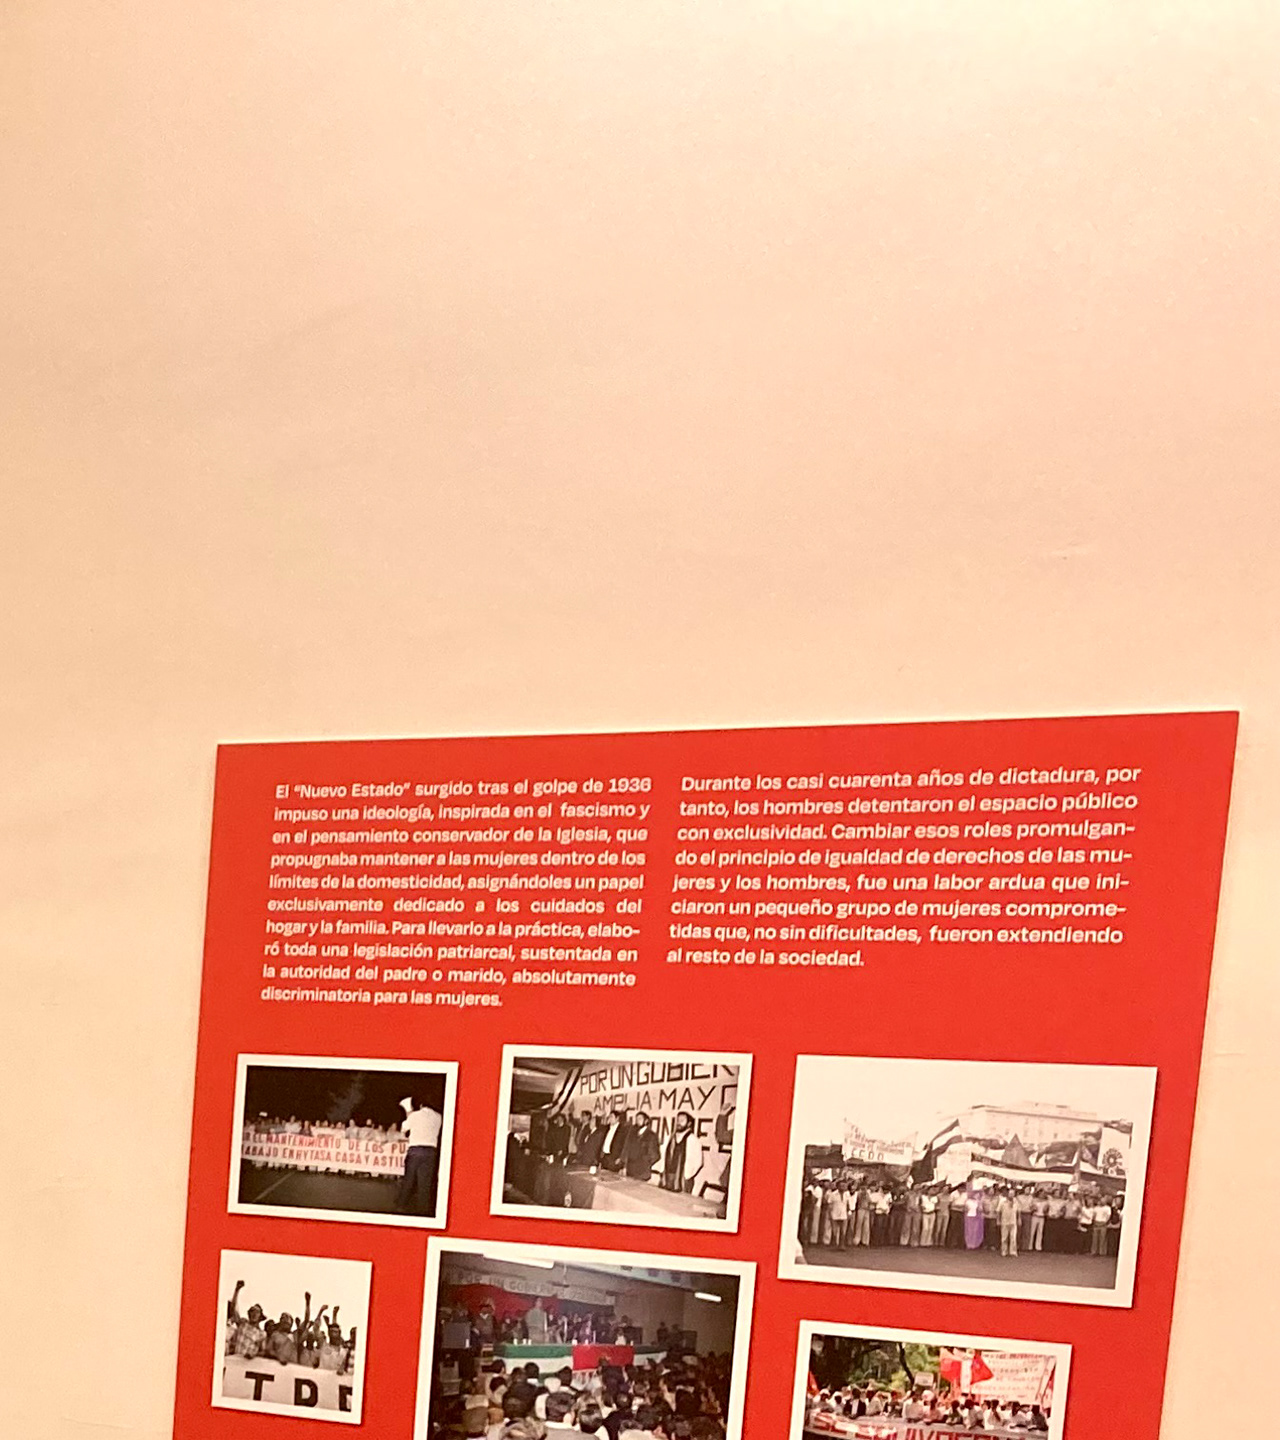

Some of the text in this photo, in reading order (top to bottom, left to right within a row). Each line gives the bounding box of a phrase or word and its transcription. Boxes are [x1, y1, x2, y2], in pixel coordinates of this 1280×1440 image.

[275, 777, 651, 799] El “Nuevo Estado” surgido tras el golpe de 1936
[681, 766, 1141, 791] Durante los casi cuarenta años de dictadura, por
[274, 801, 650, 823] impuso una ideología, inspirada en el fascismo y
[679, 791, 1138, 818] tanto, los hombres detentaron el espacio público
[272, 826, 648, 846] en el pensamiento conservador de la Iglesia, que
[677, 819, 1135, 841] con exclusividad. Cambiar esos roles promulgan-
[270, 849, 645, 869] propugnaba mantener a las mujeres dentro de los
[675, 846, 1132, 868] do el principio de igualdad de derechos de las mu-
[269, 873, 644, 892] límites de la domesticidad, asignándoles un papel
[671, 872, 1129, 893] jeres y los hombres, fue una labor ardua que ini-
[267, 897, 642, 914] exclusivamente dedicado a los cuidados del
[670, 898, 1126, 919] ciaron un pequeño grupo de mujeres comprome-
[266, 919, 640, 939] hogar y la familia. Para llevarlo a la práctica, elabo-
[669, 923, 1123, 944] tidas que, no sin dificultades, fueron extendiendo
[264, 940, 638, 962] ró toda una legislación patriarcal, sustentada en
[666, 947, 864, 966] al resto de la sociedad.
[262, 963, 636, 986] la autoridad del padre o marido, absolutamente
[260, 986, 502, 1008] discriminatoria para las mujeres.
[580, 1068, 608, 1096] POR
[610, 1062, 634, 1091] UN
[347, 1137, 361, 1151] DE
[365, 1139, 385, 1154] LOS
[334, 1151, 363, 1165] CASA
